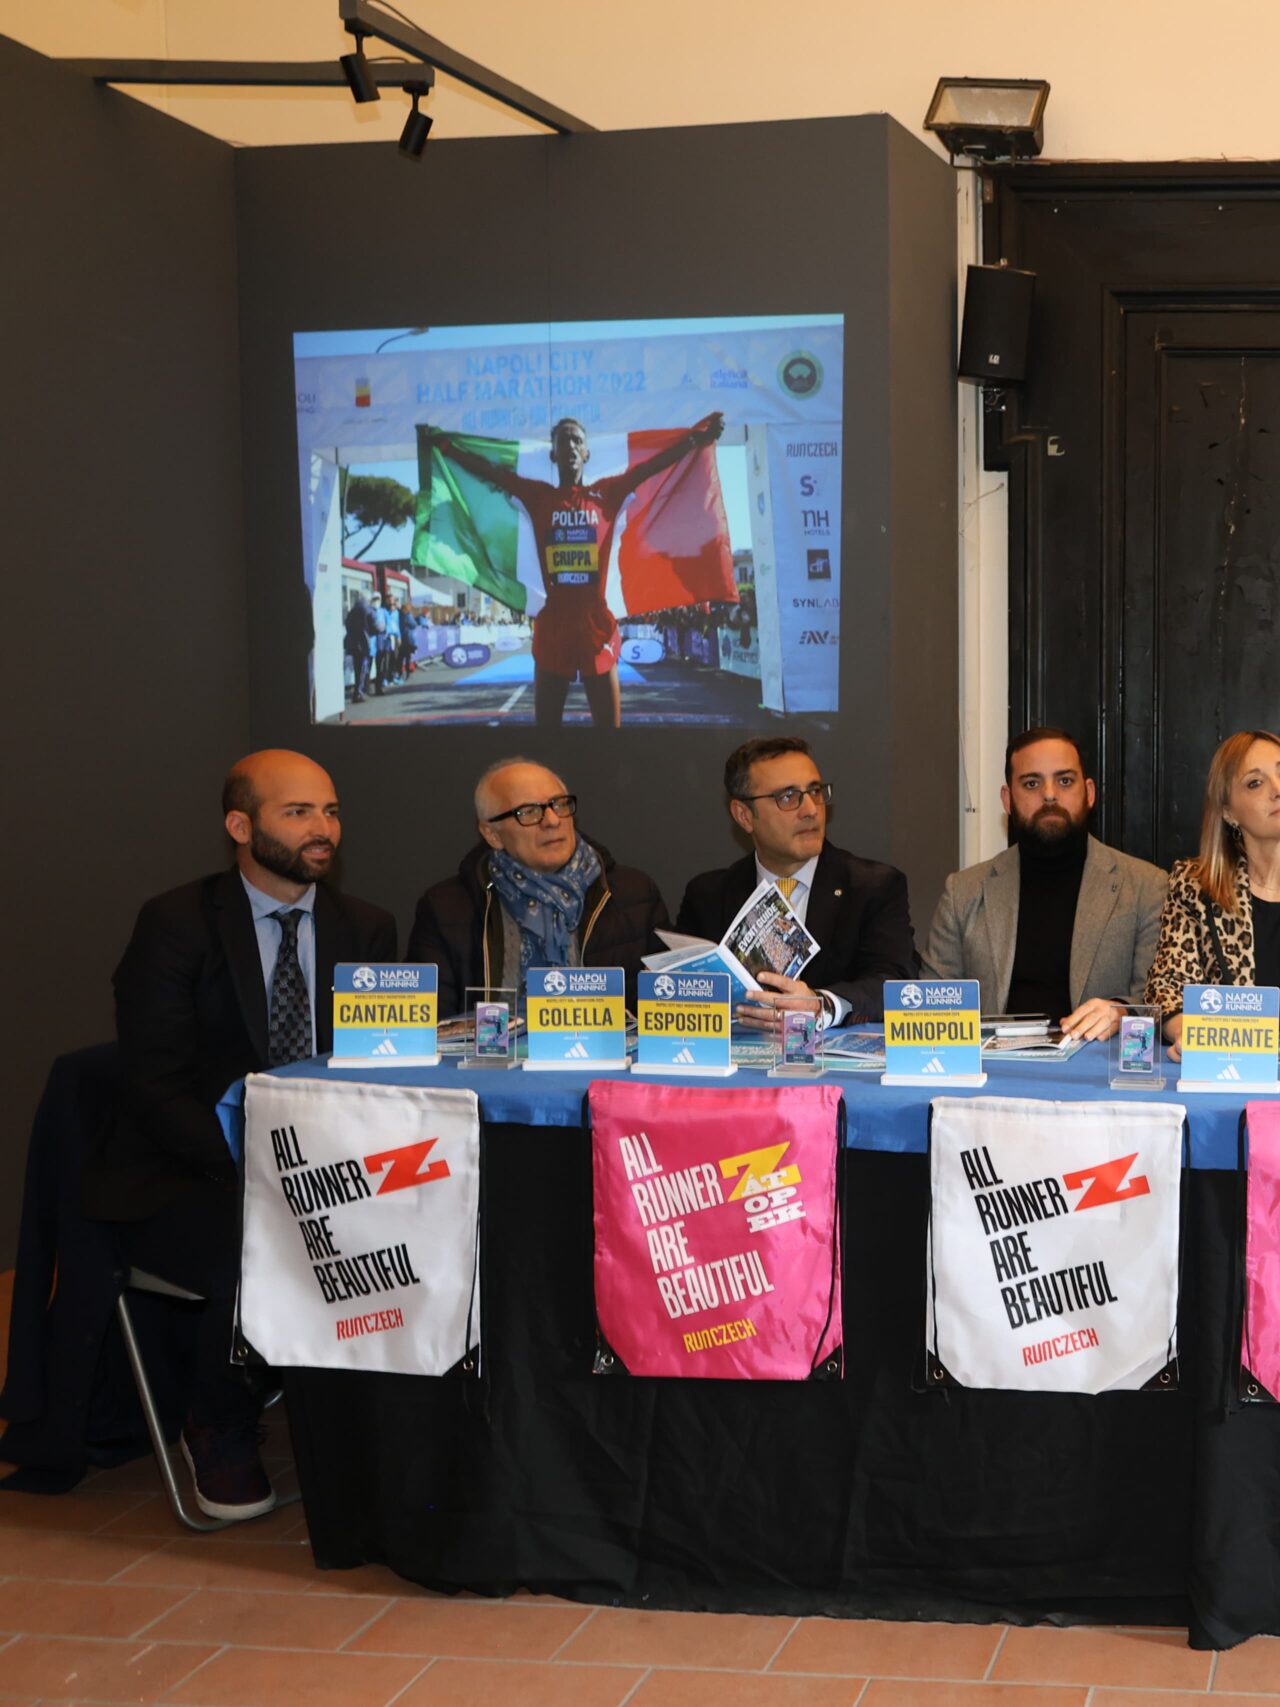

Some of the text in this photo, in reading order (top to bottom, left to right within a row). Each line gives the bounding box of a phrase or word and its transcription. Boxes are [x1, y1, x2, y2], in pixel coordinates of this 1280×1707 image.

[465, 350, 594, 376] NAPOLI CITY
[416, 370, 646, 404] HALF MARATHON 2022
[786, 442, 838, 458] RUNCZECH
[552, 509, 599, 527] POLIZIA
[552, 550, 592, 567] CRIPPA
[738, 902, 778, 953] EVENT GUIDE
[380, 970, 420, 979] NAPOLI
[380, 980, 420, 989] RUNNING
[569, 973, 607, 983] NAPOLI
[678, 978, 714, 989] NAPOLI
[569, 983, 607, 992] RUNNING
[678, 989, 714, 998] RUNNING
[925, 986, 963, 997] NAPOLI
[1225, 992, 1263, 1003] NAPOLI
[339, 1003, 431, 1024] CANTALES
[925, 997, 963, 1005] RUNNING
[1225, 1003, 1262, 1012] RUNNING
[539, 1007, 613, 1027] COLELLA
[644, 1011, 723, 1033] ESPOSITO
[890, 1021, 974, 1042] MINOPOLI
[1186, 1025, 1274, 1049] FERRANTE
[271, 1126, 307, 1171] ALL
[619, 1132, 663, 1181] ALL
[960, 1146, 1004, 1190] ALL
[281, 1160, 371, 1217] RUNNER
[631, 1162, 724, 1227] RUNNER
[974, 1177, 1069, 1235] RUNNER
[299, 1215, 341, 1261] ARE
[646, 1221, 695, 1274] ARE
[989, 1231, 1038, 1283] ARE
[313, 1244, 420, 1304] BEAUTIFUL
[657, 1250, 775, 1320] BEAUTIFUL
[1000, 1261, 1118, 1330] BEAUTIFUL
[336, 1308, 404, 1340] RUNCZECH
[683, 1318, 757, 1353] RUNCZECH
[1022, 1328, 1100, 1367] RUNCZECH
